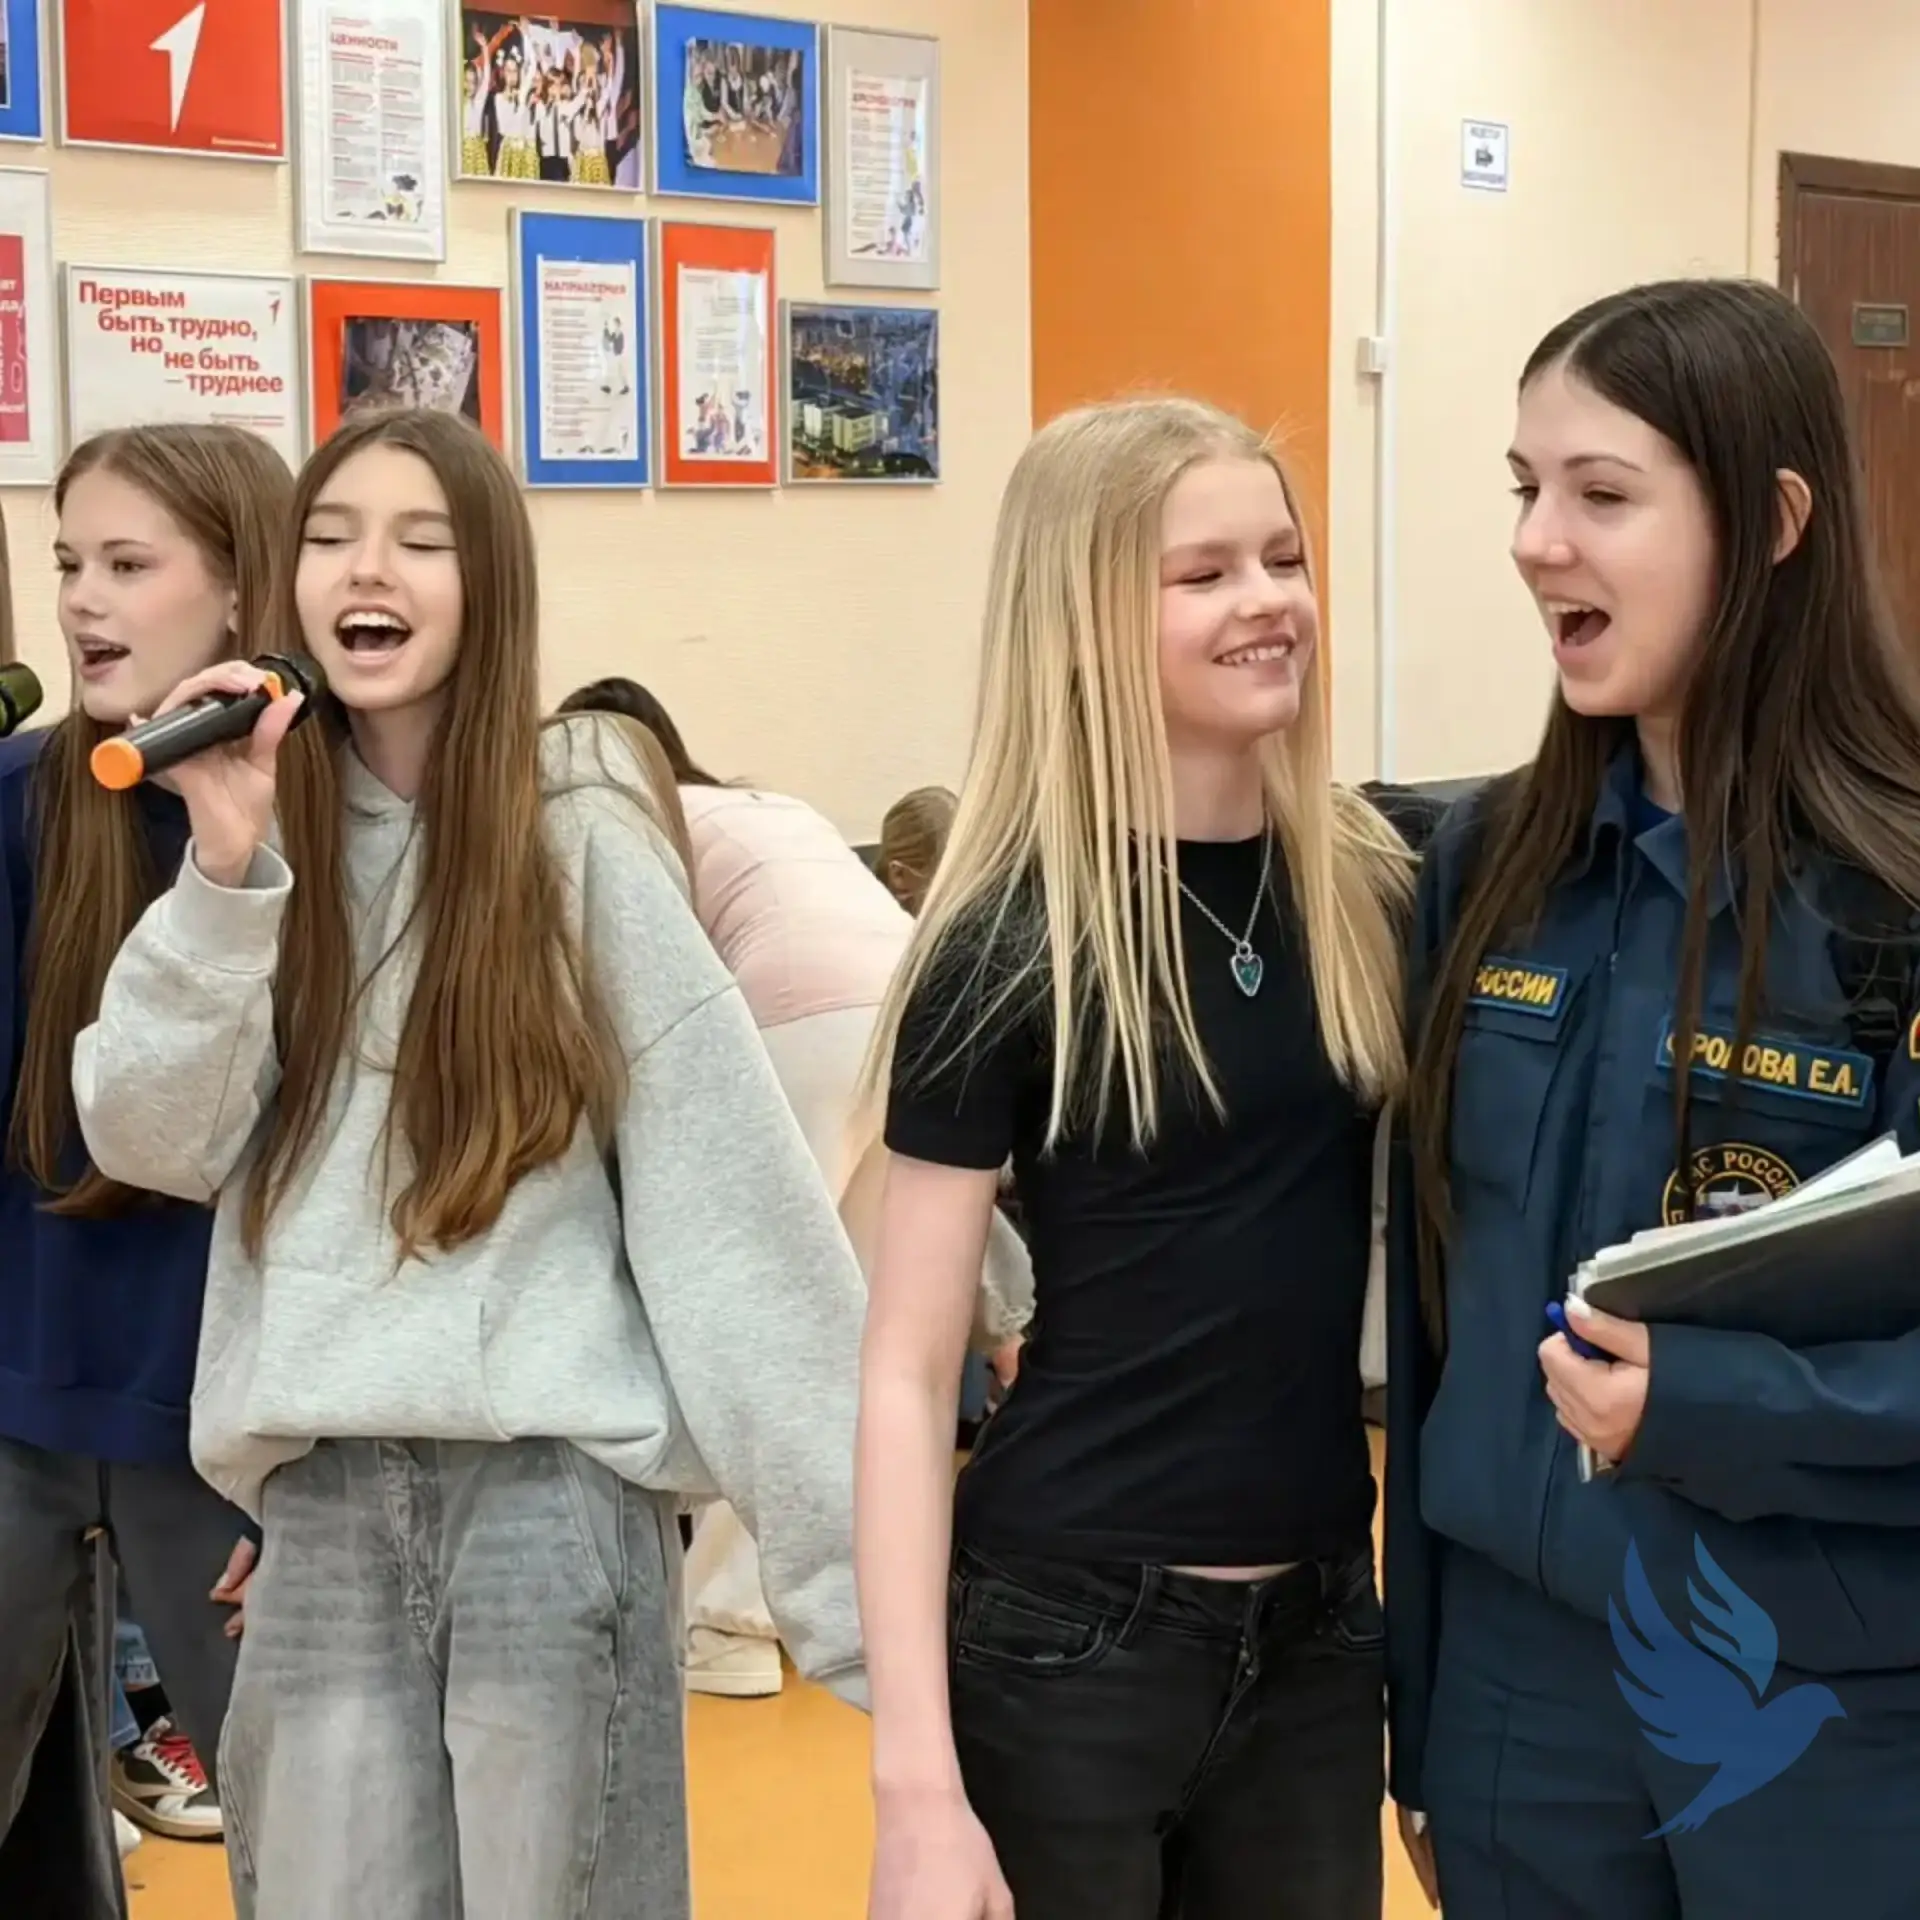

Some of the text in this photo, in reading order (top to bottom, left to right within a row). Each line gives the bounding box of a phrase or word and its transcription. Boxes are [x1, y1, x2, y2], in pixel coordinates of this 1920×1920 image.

[79, 281, 185, 309] Первым
[98, 308, 258, 341] быть трудно,
[131, 336, 163, 353] но
[164, 347, 260, 371] не быть
[186, 374, 284, 396] труднее
